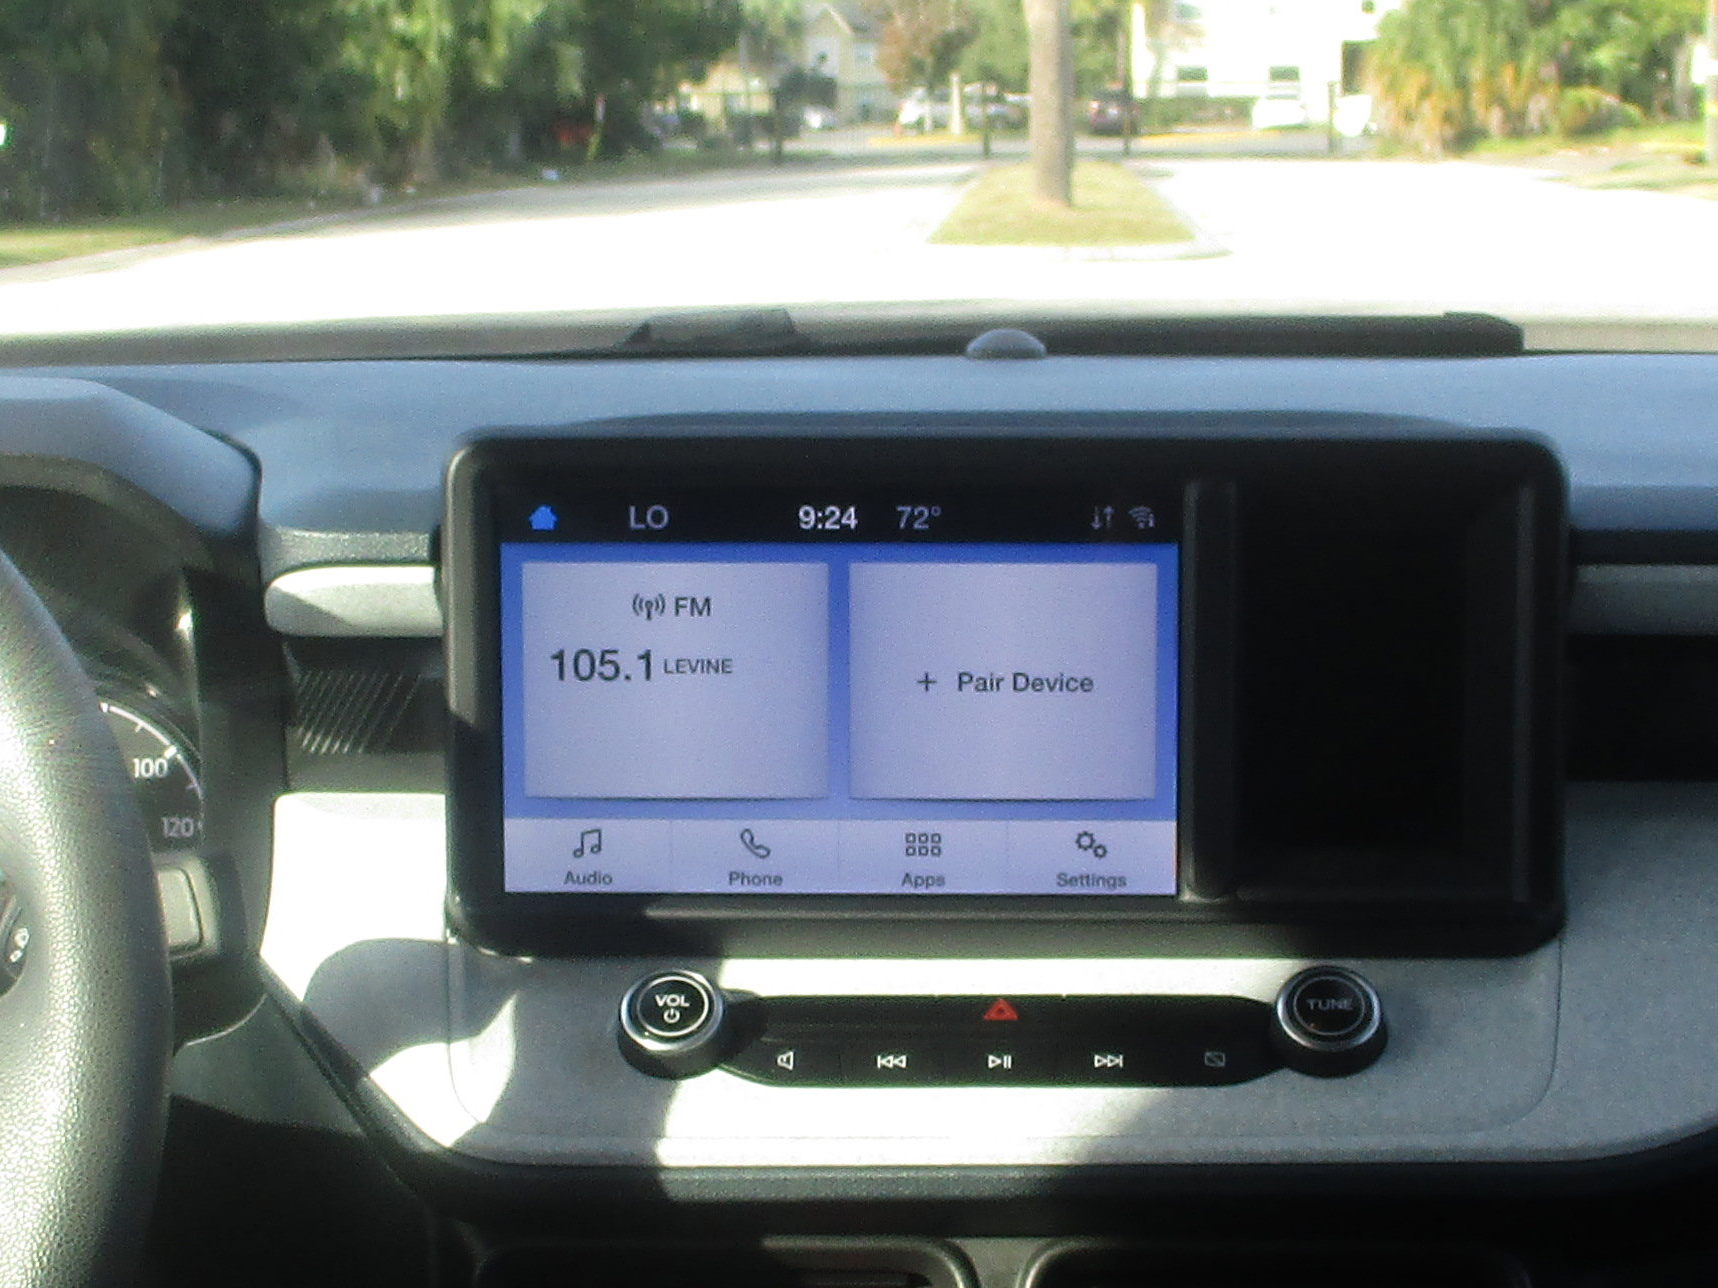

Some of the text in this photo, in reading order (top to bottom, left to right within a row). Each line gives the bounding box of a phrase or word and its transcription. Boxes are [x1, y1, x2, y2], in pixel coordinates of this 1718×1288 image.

[628, 506, 669, 530] LO
[798, 506, 858, 529] 9:24
[896, 506, 941, 529] 72°
[674, 597, 711, 617] FM
[550, 648, 733, 681] 105.1 LEVINE
[957, 673, 1094, 692] Pair Device
[133, 758, 168, 778] 100
[161, 817, 194, 837] 120
[563, 871, 613, 886] Audio
[728, 871, 783, 887] Phone
[901, 873, 946, 889] Apps
[1056, 873, 1127, 889] Settings
[655, 994, 690, 1007] VOL
[1306, 998, 1353, 1011] TUNE
